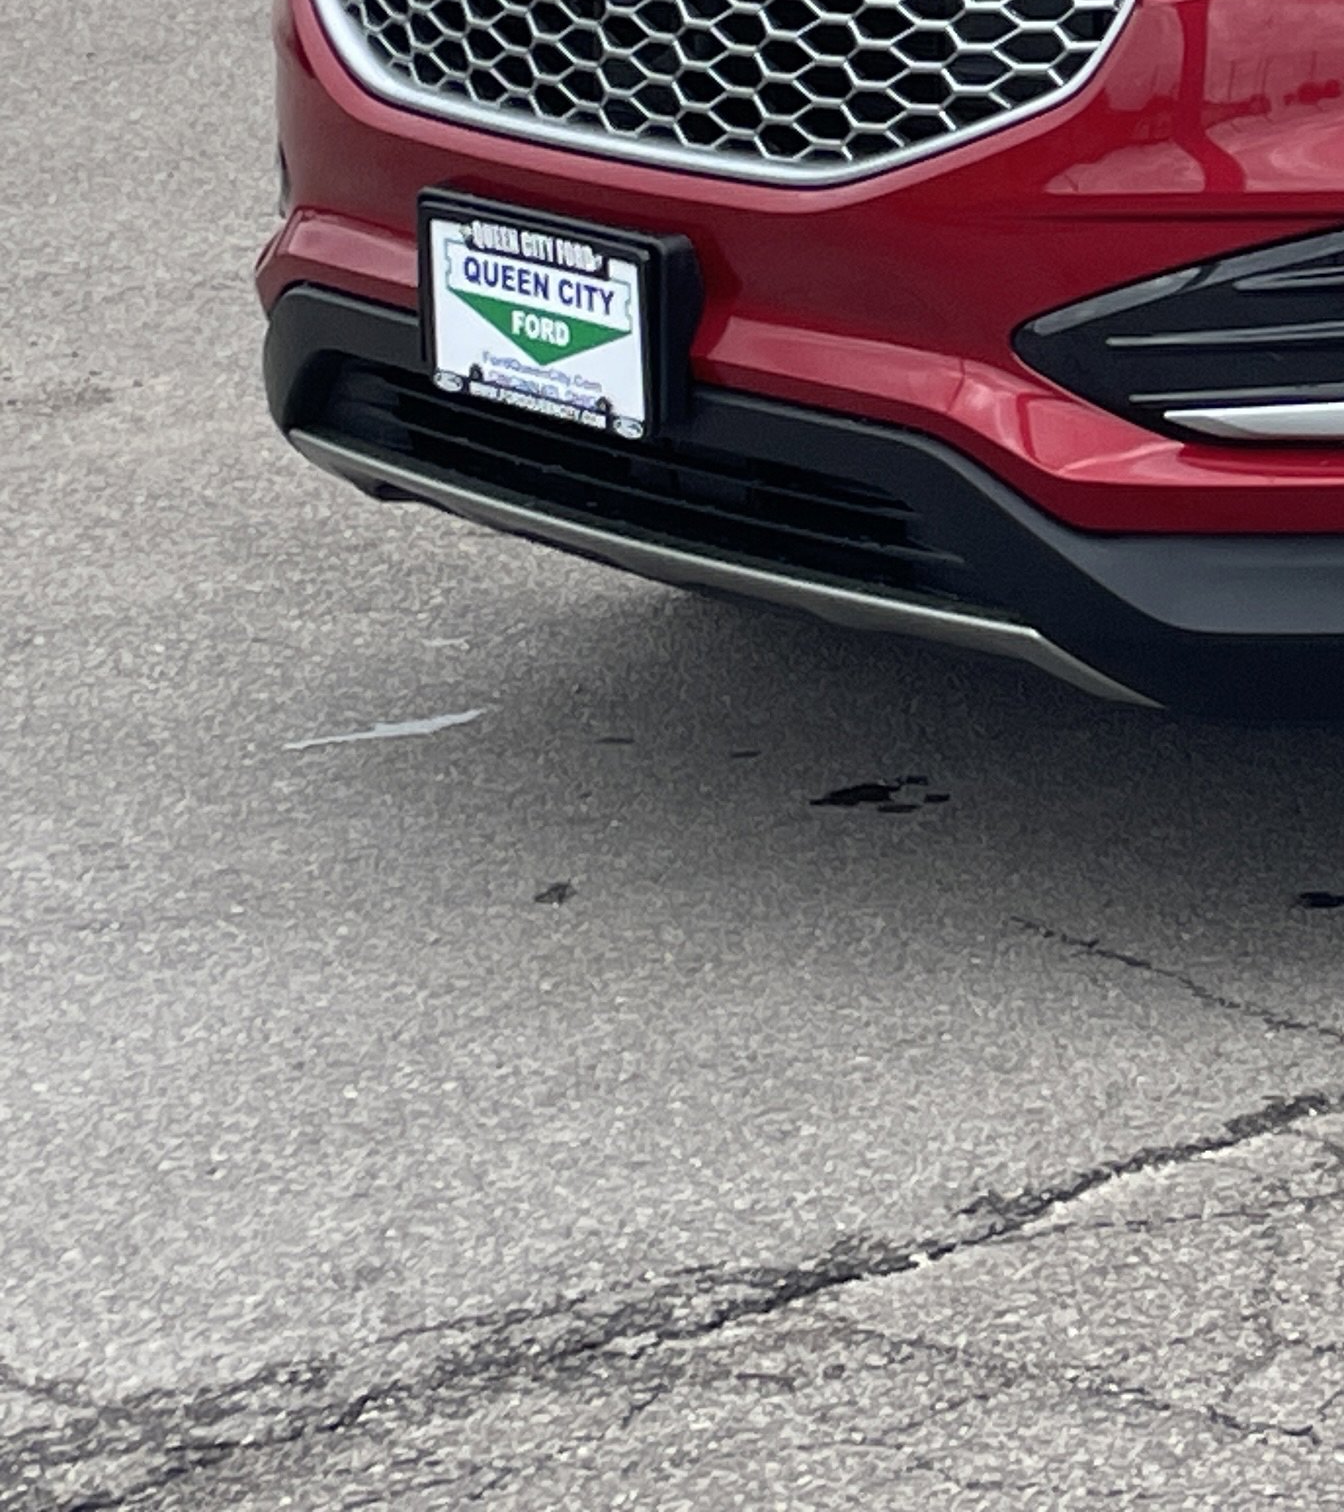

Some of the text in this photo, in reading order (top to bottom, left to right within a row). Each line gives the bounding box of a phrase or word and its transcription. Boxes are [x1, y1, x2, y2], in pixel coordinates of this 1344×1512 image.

[472, 220, 595, 271] QUEEN CITY FORD
[464, 256, 615, 316] QUEEN CITY
[511, 310, 571, 347] FORD
